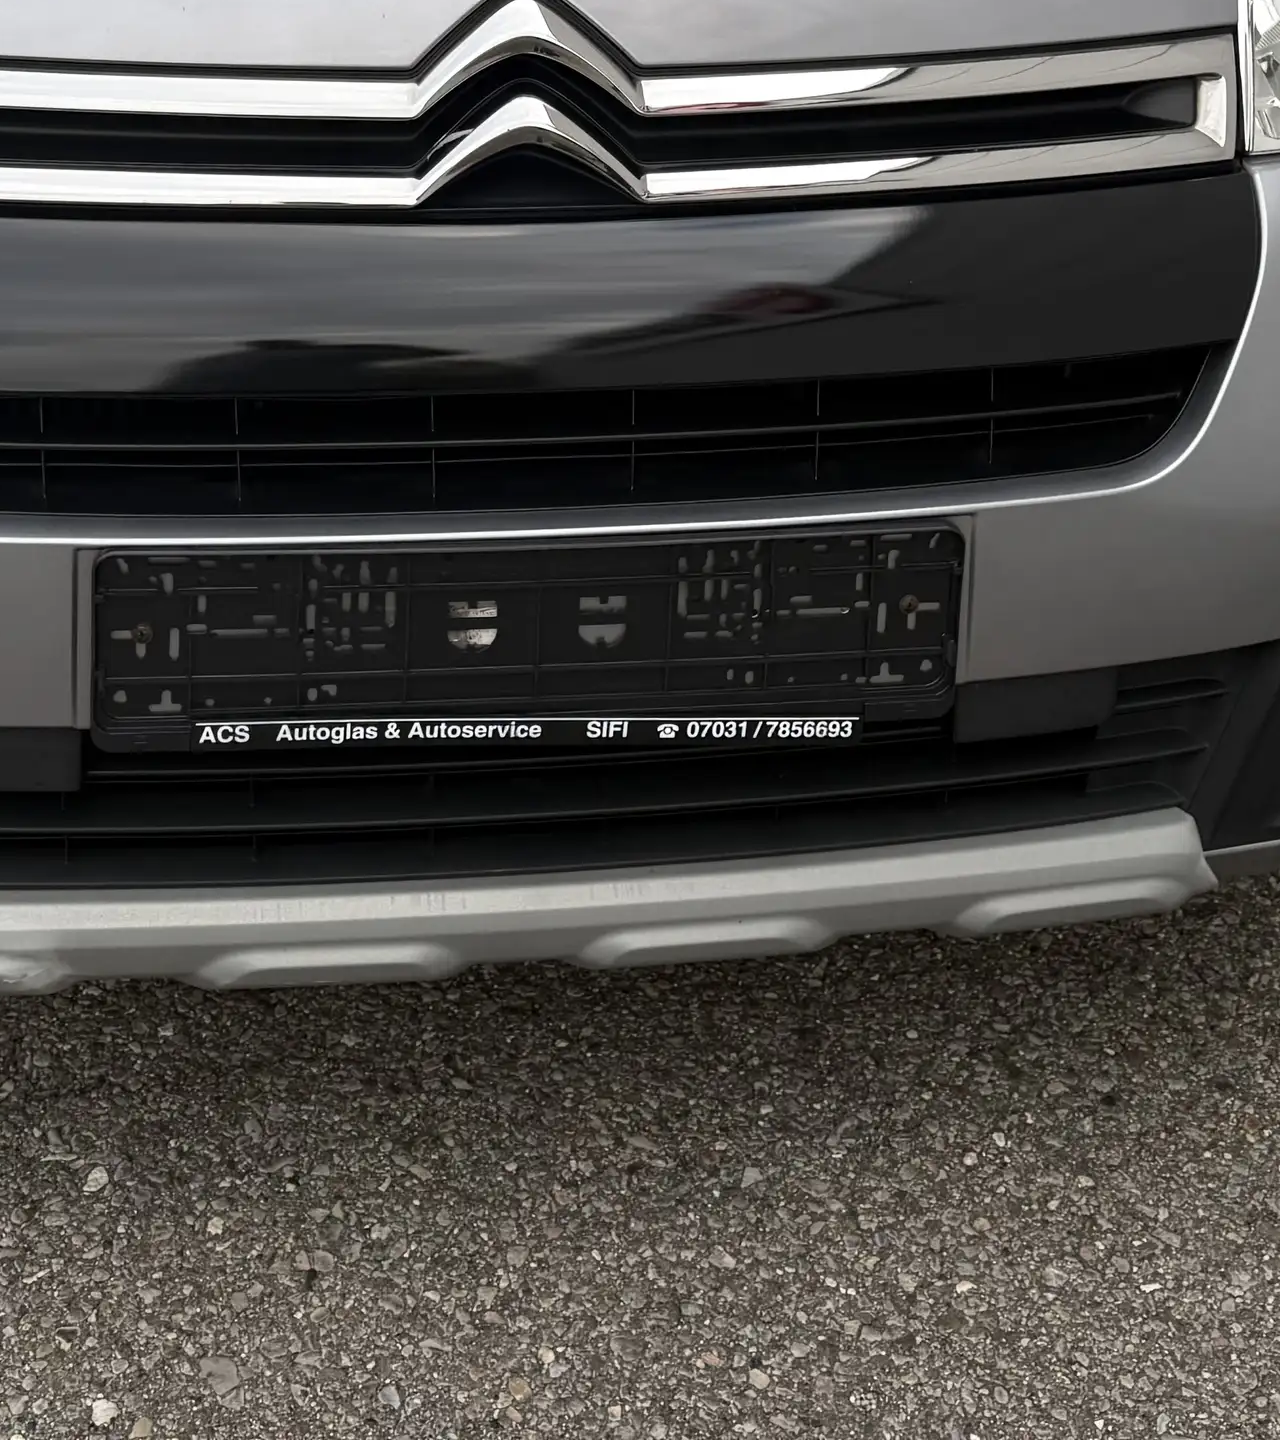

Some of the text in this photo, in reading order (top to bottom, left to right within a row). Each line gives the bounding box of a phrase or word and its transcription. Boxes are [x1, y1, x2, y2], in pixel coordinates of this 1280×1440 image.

[198, 725, 250, 744] ACS
[275, 723, 378, 745] Autoglas
[384, 722, 401, 739] &
[407, 720, 542, 740] Autoservice
[586, 720, 629, 739] SIFI
